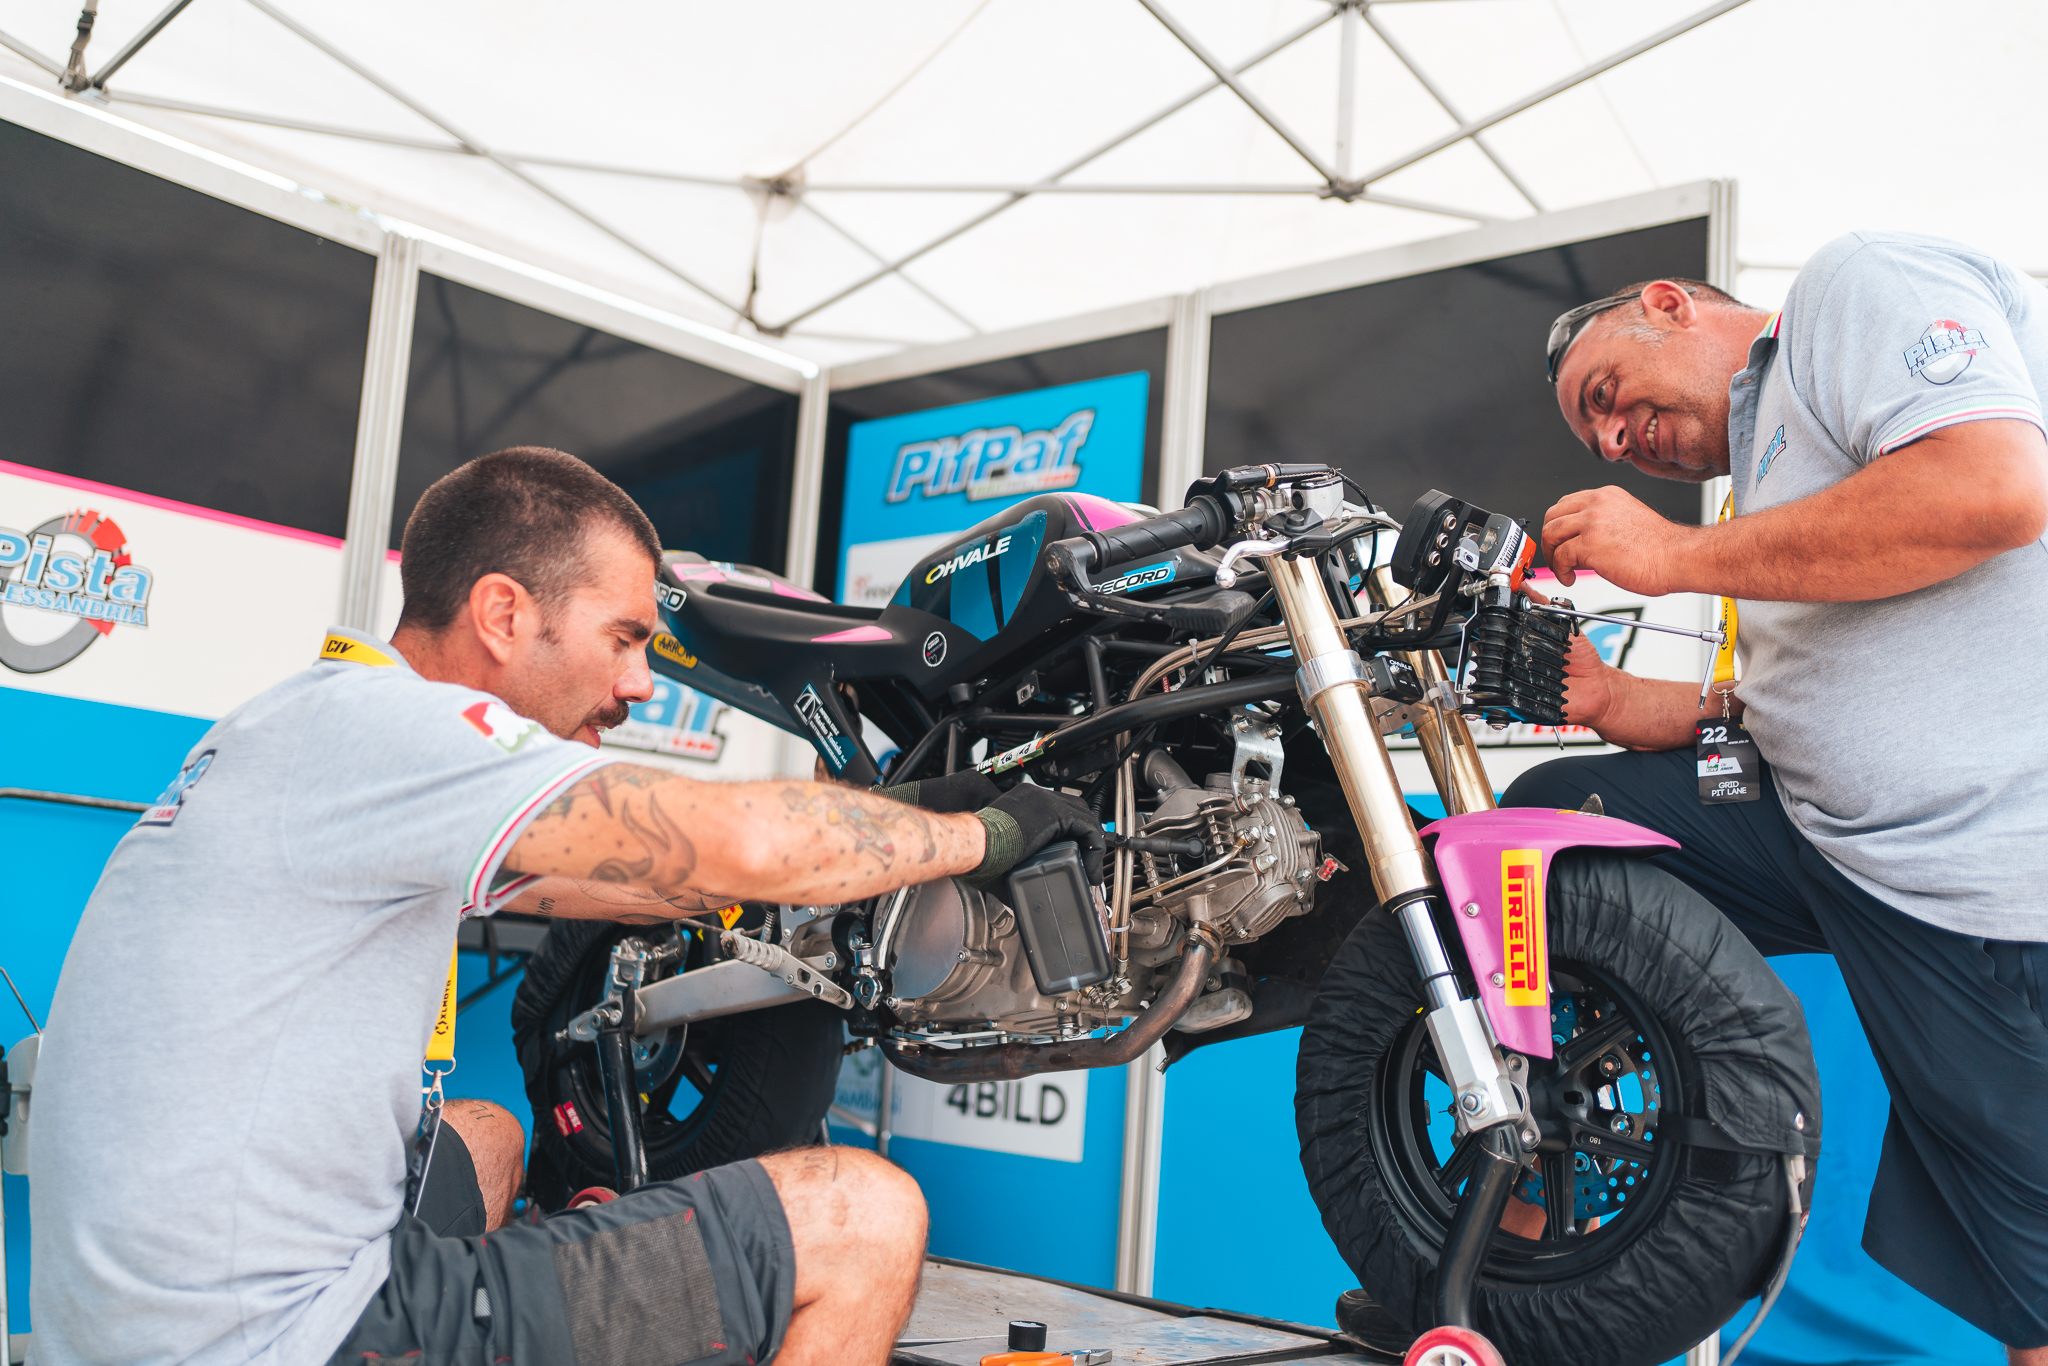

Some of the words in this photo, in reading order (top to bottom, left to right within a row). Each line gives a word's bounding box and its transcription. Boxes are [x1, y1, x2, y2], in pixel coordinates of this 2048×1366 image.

[1904, 328, 1984, 369] Pista
[888, 409, 1095, 502] PifPaf
[0, 527, 152, 606] Pista
[925, 535, 1012, 585] OHVALE
[0, 583, 147, 627] ESSANDRIA
[326, 640, 355, 653] CIV
[658, 636, 693, 661] ARROW
[813, 712, 829, 735] Marino
[1702, 726, 1728, 744] 22
[1711, 789, 1725, 797] PIT
[1727, 787, 1747, 796] LANE
[1718, 780, 1740, 789] GRID
[1508, 865, 1538, 991] PIRELLI
[440, 979, 451, 1020] XLMOTO
[947, 1082, 1066, 1125] 4BILD
